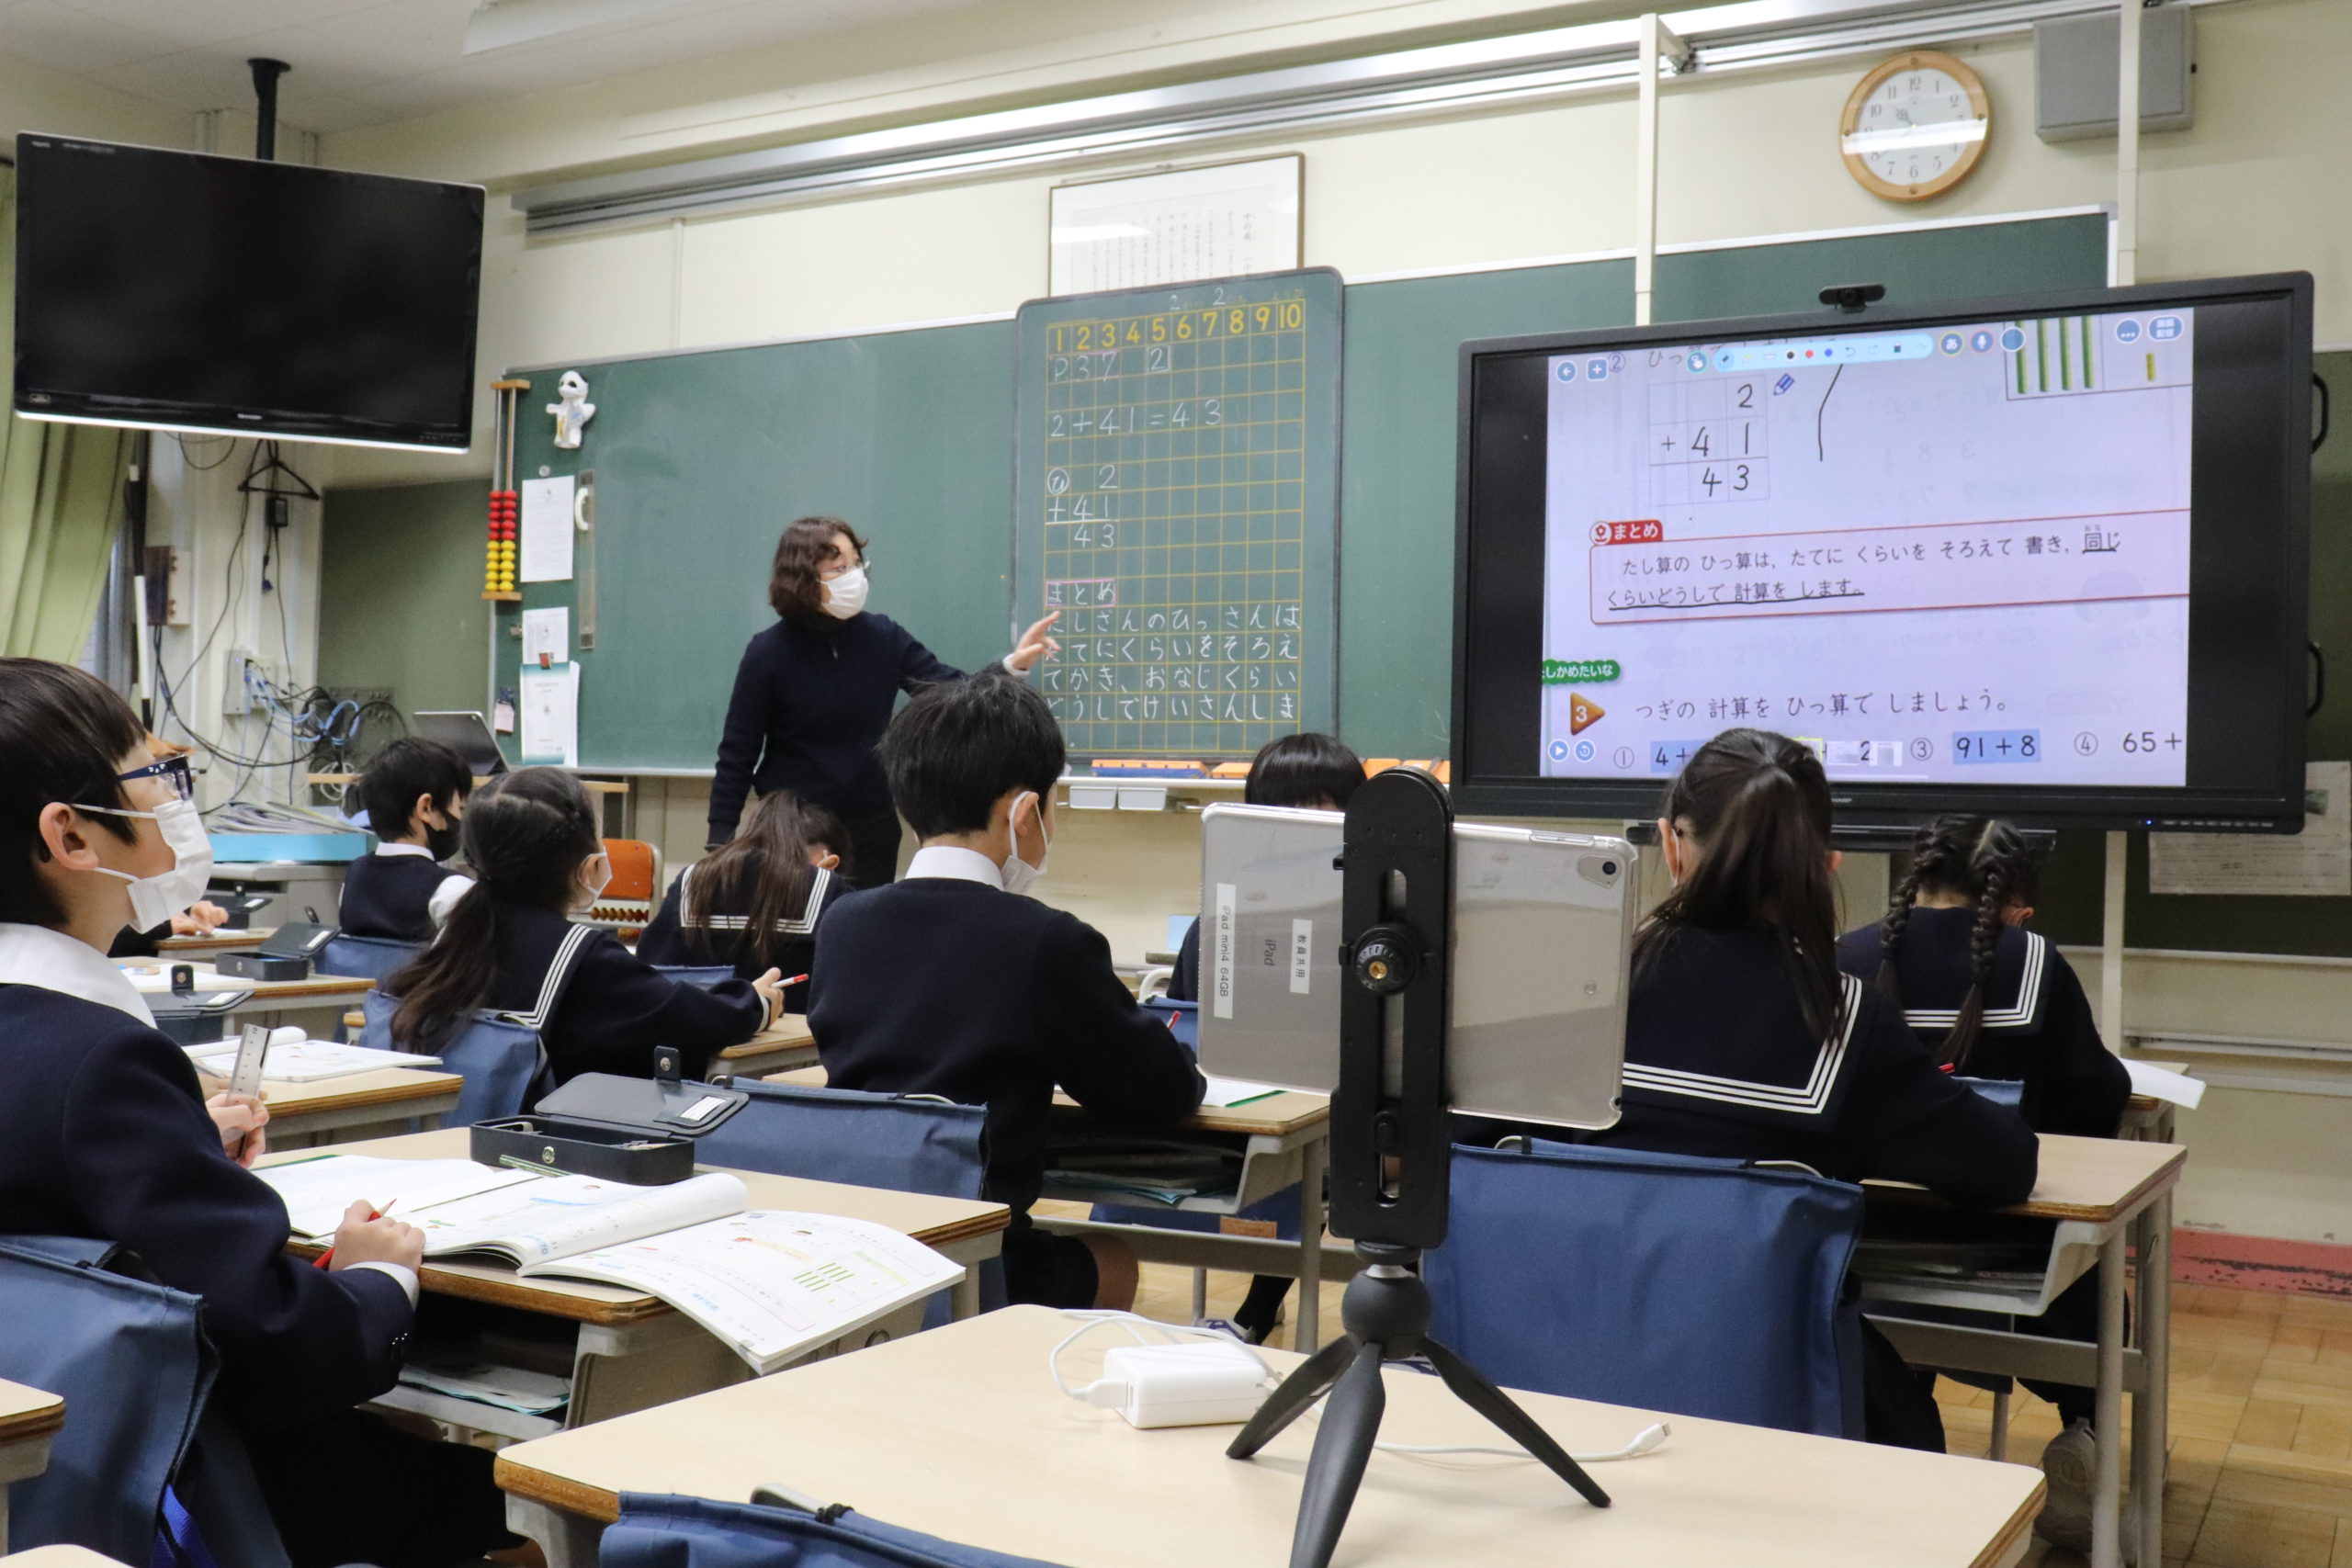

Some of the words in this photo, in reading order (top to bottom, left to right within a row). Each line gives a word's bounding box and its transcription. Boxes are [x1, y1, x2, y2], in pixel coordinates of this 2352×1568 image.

[1887, 85, 1897, 99] 11
[1909, 76, 1922, 91] 12
[1935, 80, 1939, 94] 1
[1871, 104, 1882, 118] 10
[1950, 94, 1959, 107] 2
[1888, 161, 1895, 175] 7
[1909, 164, 1918, 178] 6
[1933, 156, 1941, 170] 5
[1213, 287, 1226, 306] 2
[1057, 329, 1062, 353] 1
[1077, 326, 1091, 351] 2
[1102, 323, 1116, 348] 3
[1125, 321, 1141, 343] 4
[1151, 317, 1166, 342] 5
[1177, 315, 1192, 340] 6
[1203, 311, 1218, 337] 7
[1229, 310, 1244, 334] 8
[1255, 306, 1270, 332] 9
[1280, 303, 1301, 330] 10
[1150, 347, 1166, 372] 2
[1737, 384, 1753, 408] 2
[1099, 464, 1118, 489] 2
[1702, 465, 1749, 497] 43
[1074, 524, 1114, 548] 43
[1614, 523, 1658, 540] まとめ
[1623, 557, 1690, 575] たし算の
[1792, 548, 1843, 566] たてに
[1858, 543, 1926, 563] くらいを
[1940, 538, 2012, 558] そろえて
[2085, 532, 2120, 551] 同じ
[1048, 581, 1115, 605] まとめ
[1735, 581, 1785, 602] 計算を
[1576, 705, 1588, 723] 3
[1635, 699, 1695, 720] つぎの
[1708, 696, 1770, 719] 計算を
[1788, 693, 1873, 716] ひっ算で
[1891, 689, 2006, 714] しましょう。
[1221, 905, 1230, 931] iPad
[1264, 939, 1276, 966] iPad
[1219, 967, 1229, 997] 64GB
